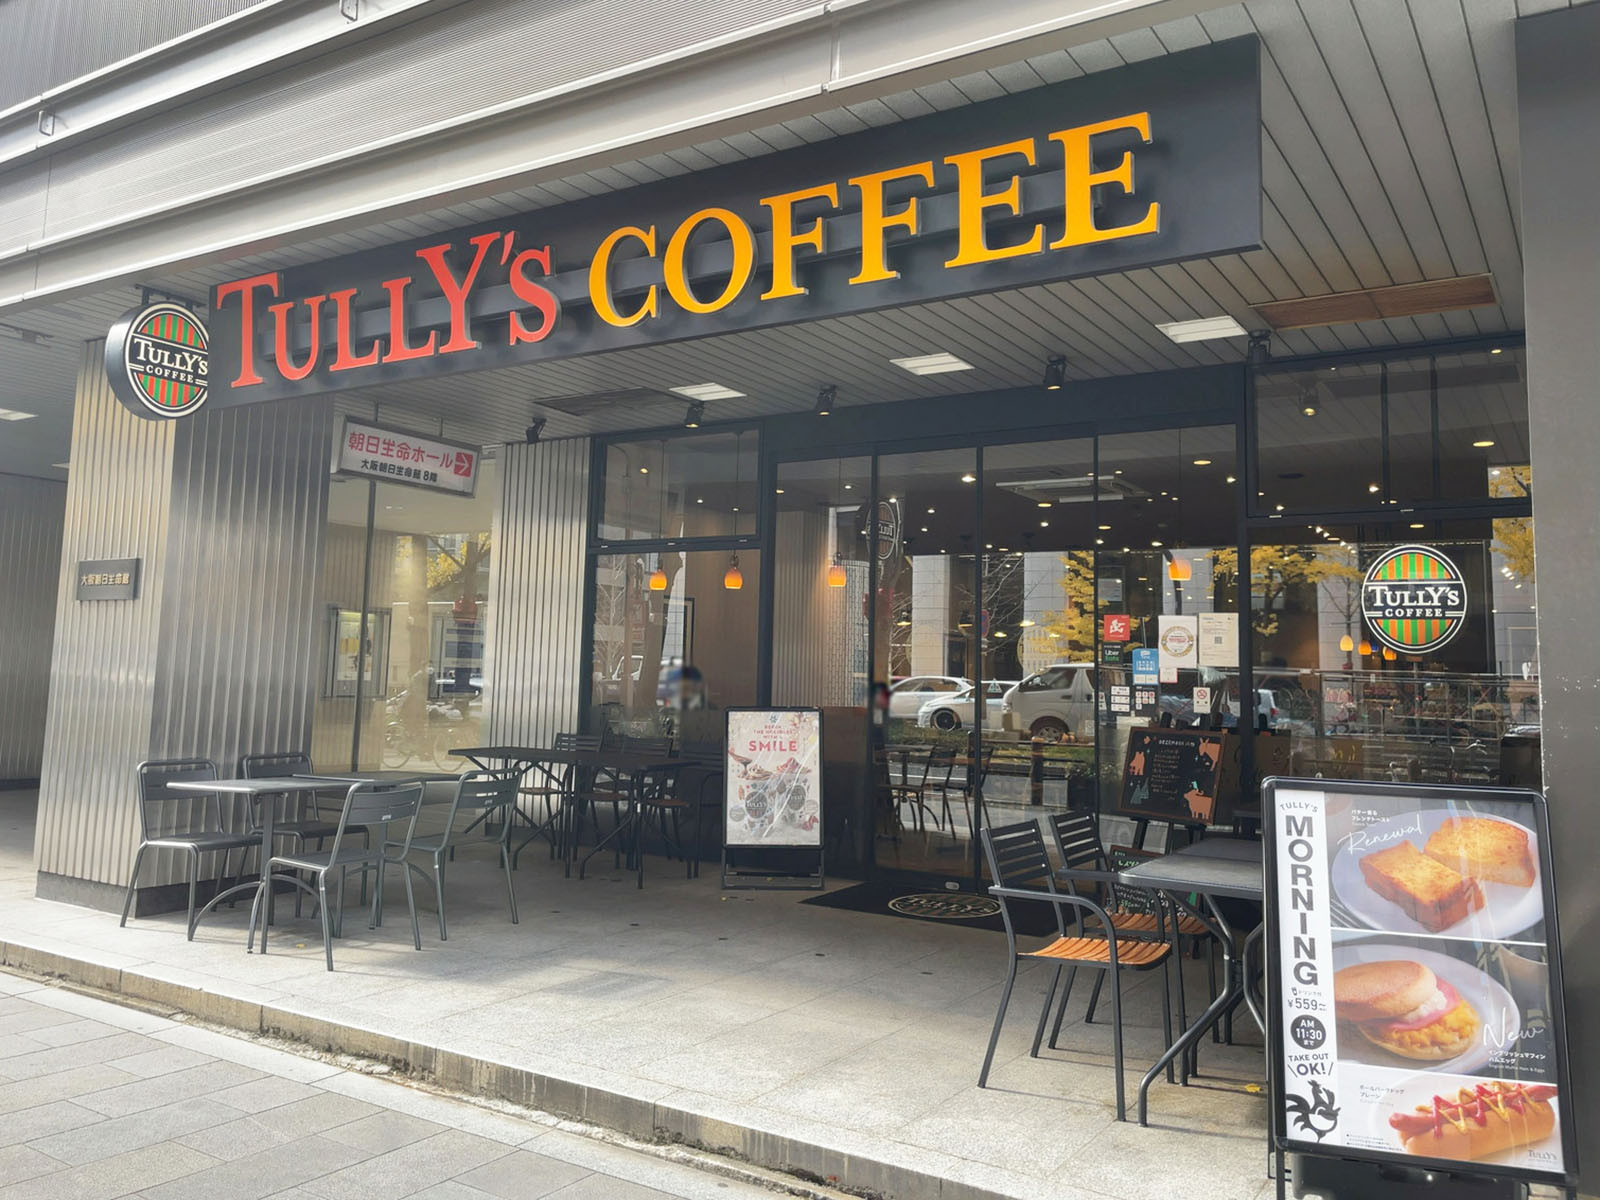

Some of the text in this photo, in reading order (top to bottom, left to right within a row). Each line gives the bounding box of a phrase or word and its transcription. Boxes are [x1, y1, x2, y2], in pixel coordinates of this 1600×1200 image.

[216, 111, 1161, 389] TULLY'S COFFEE
[134, 338, 208, 376] TULLY'S
[146, 365, 194, 383] COFFEE
[348, 431, 453, 469] 朝日生命ホール
[1368, 586, 1460, 606] TULLY'S
[1385, 608, 1443, 617] COFFEE
[749, 740, 798, 752] SMILE
[1280, 802, 1318, 813] TULLY'S
[1337, 814, 1422, 854] Renewal
[1285, 815, 1319, 986] MORNING
[1300, 1020, 1315, 1028] AM
[1483, 1007, 1544, 1048] New
[1296, 1028, 1322, 1040] 11:30
[1296, 1062, 1326, 1076] OK!
